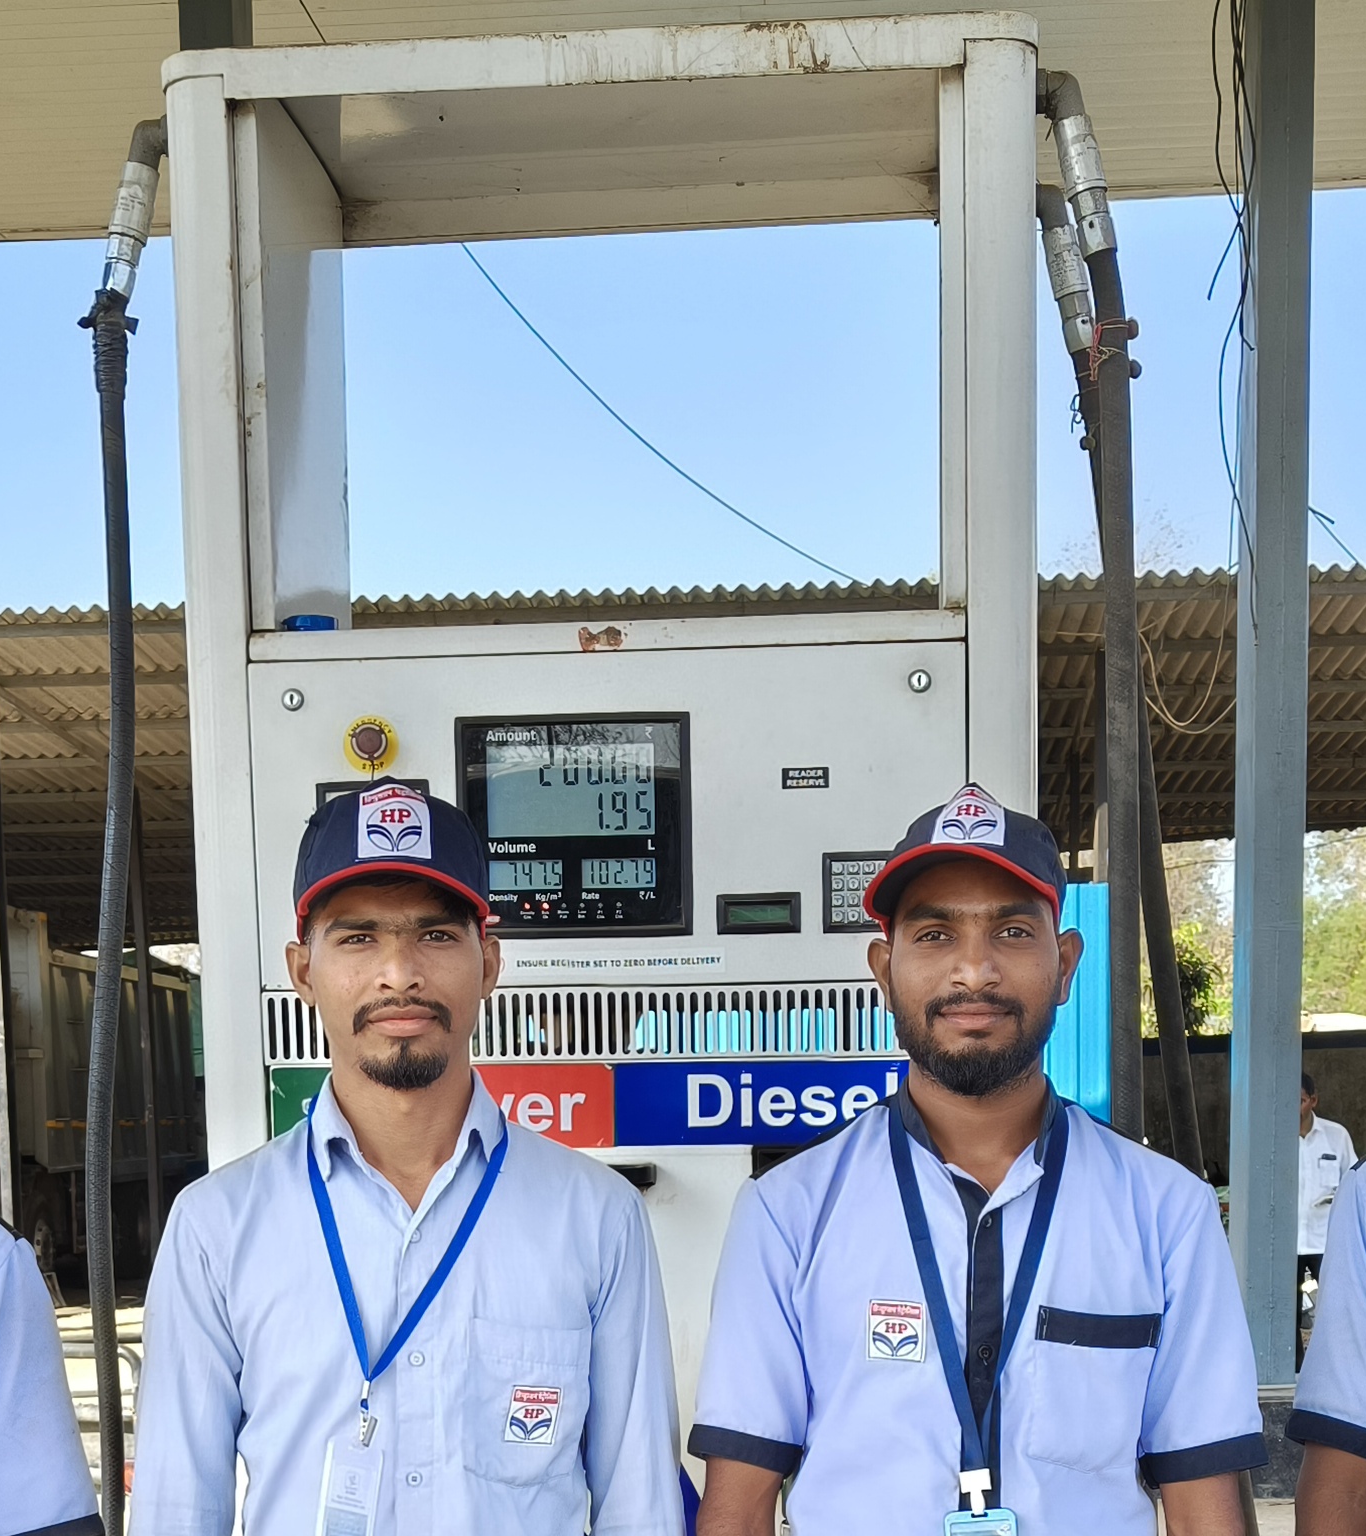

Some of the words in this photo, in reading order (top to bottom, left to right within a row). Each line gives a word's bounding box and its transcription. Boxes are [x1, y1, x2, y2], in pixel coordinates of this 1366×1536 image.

[486, 730, 536, 742] Amount
[380, 808, 411, 823] HP
[598, 791, 651, 830] 1.95
[956, 804, 986, 817] HP
[488, 842, 536, 853] Volume
[648, 839, 655, 850] L
[509, 861, 561, 886] 747.5
[591, 860, 653, 884] 102.79
[489, 894, 518, 902] Density
[551, 959, 590, 968] REGISTER
[624, 959, 645, 967] ZERO
[647, 958, 678, 967] BEFORE
[681, 957, 721, 965] DELIVERY
[885, 1322, 908, 1334] HP
[523, 1408, 544, 1418] HP
